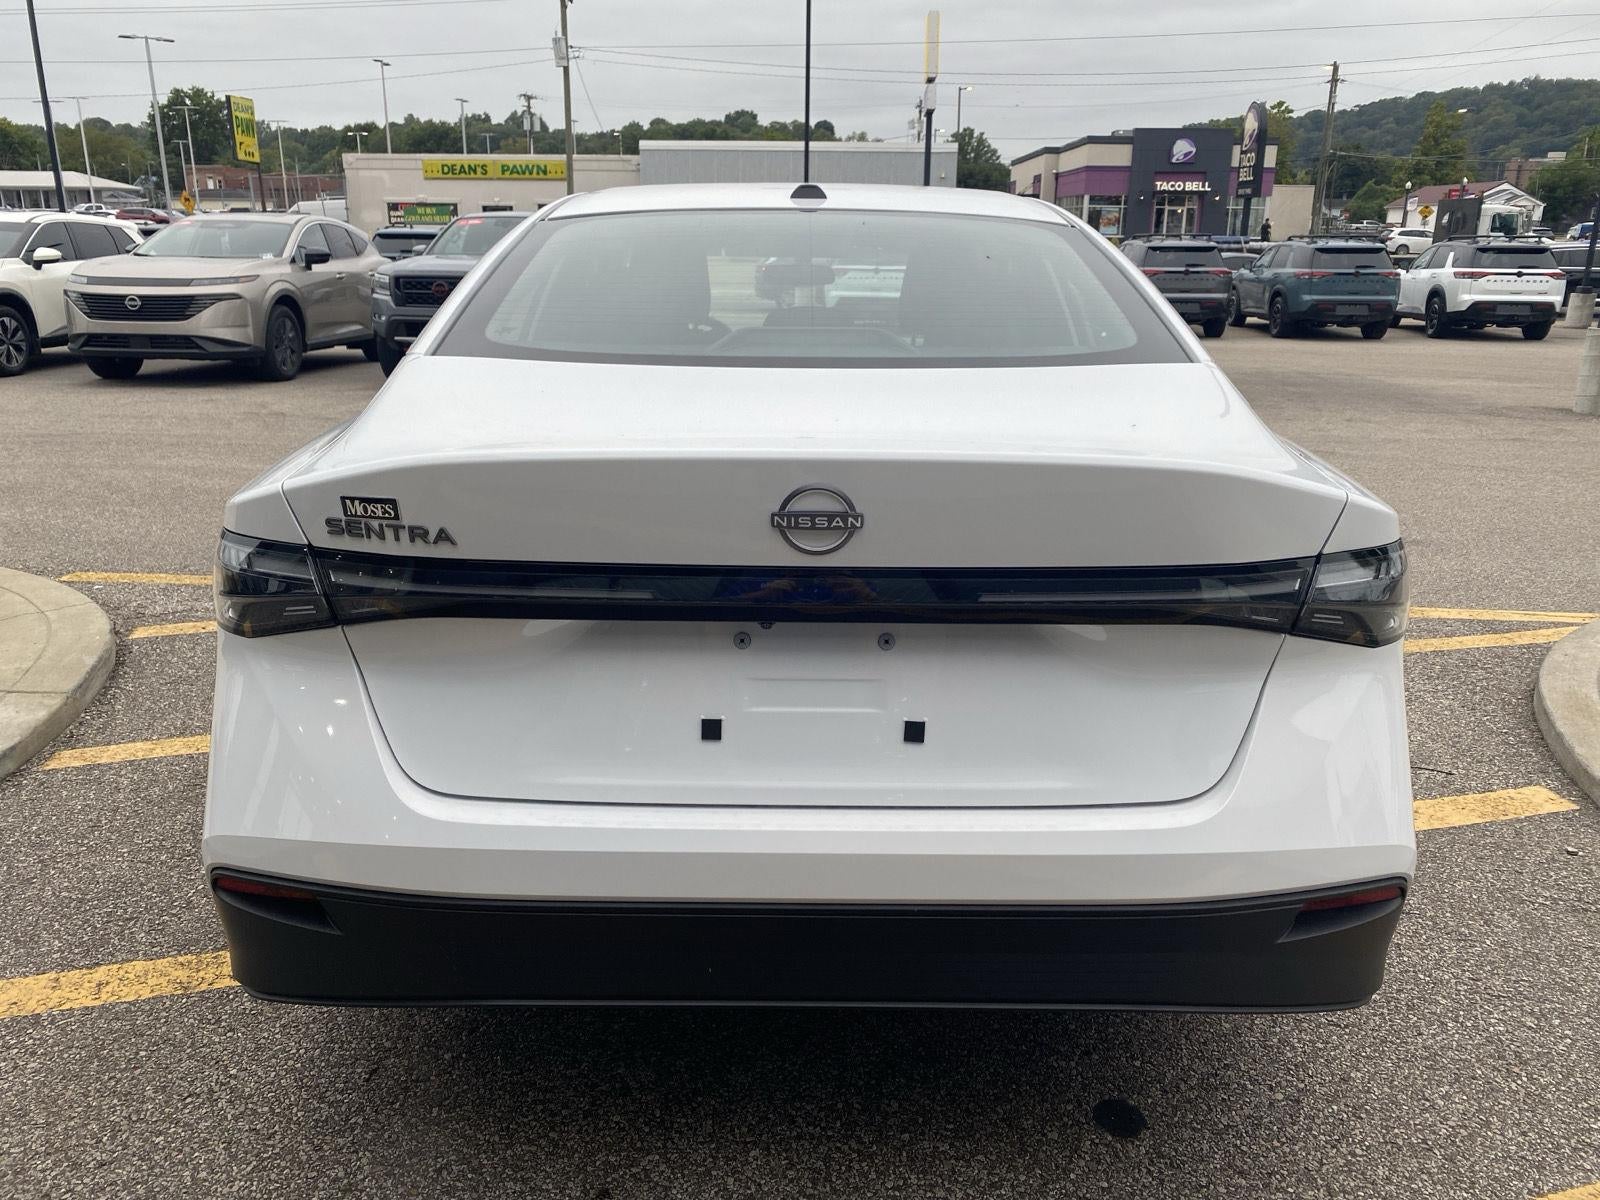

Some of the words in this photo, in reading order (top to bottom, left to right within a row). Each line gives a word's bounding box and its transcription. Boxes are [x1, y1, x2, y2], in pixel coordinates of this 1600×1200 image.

[235, 115, 255, 138] PAWN
[1240, 152, 1255, 167] TACO
[441, 163, 488, 175] DEAN'S
[501, 164, 548, 175] PAWN
[1239, 167, 1254, 182] BELL
[1155, 181, 1184, 191] TACO
[1185, 181, 1211, 191] BELL
[773, 516, 861, 528] NISSAN
[324, 517, 458, 546] SENTRA
